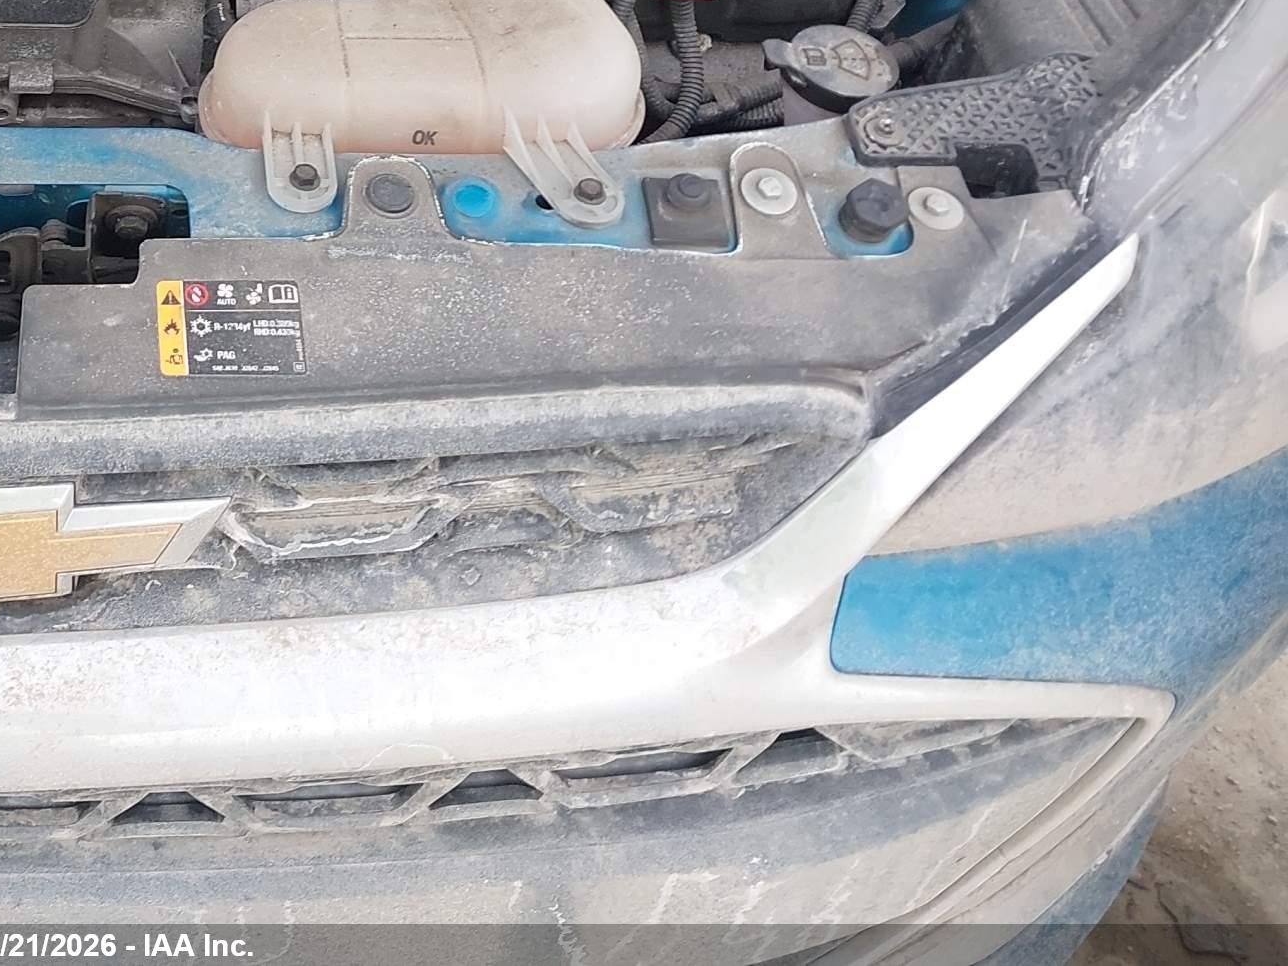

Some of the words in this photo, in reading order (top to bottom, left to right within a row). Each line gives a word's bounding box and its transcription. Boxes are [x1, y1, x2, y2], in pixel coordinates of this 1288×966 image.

[412, 130, 439, 146] OK
[216, 297, 237, 306] AUTO
[217, 350, 236, 360] PAG
